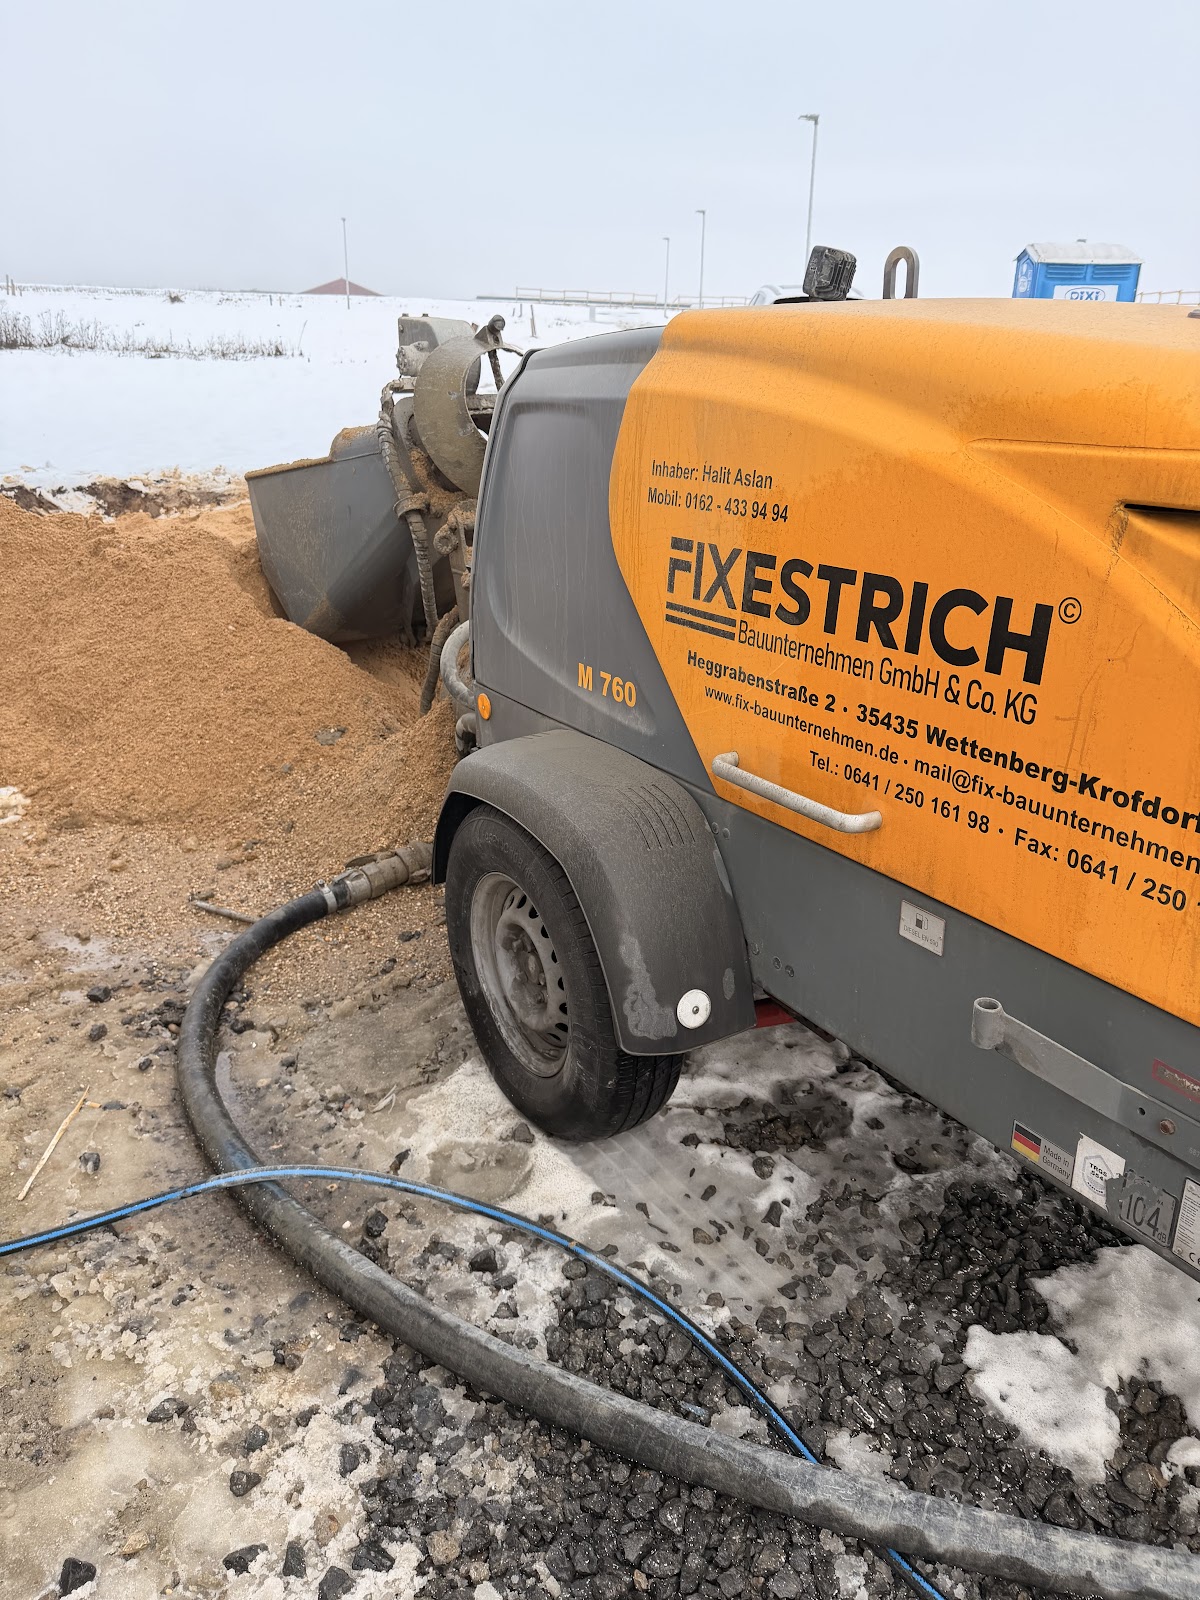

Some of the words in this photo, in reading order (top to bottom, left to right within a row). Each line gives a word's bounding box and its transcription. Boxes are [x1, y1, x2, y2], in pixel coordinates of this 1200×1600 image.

[652, 460, 698, 480] Inhaber:
[702, 463, 731, 484] Halit
[733, 468, 773, 490] Aslan
[647, 487, 681, 507] Mobil:
[685, 493, 713, 512] 0162
[724, 498, 747, 517] 433
[751, 501, 768, 520] 94
[771, 504, 789, 522] 94
[578, 662, 593, 692] M
[600, 671, 637, 708] 760
[738, 620, 874, 681] Bauunternehmen
[879, 657, 940, 699] GmbH
[944, 674, 960, 706] &
[966, 679, 997, 716] Co.
[1003, 688, 1038, 726] KG
[687, 650, 819, 707] Heggrabenstraße
[824, 694, 836, 713] 2
[856, 703, 918, 740] 35435
[704, 685, 899, 765] www.fix-bauunternehmen.de
[914, 756, 1200, 875] mail@fix-bauunternehmen
[809, 750, 839, 776] Tel.:
[844, 764, 879, 791] 0641
[884, 779, 891, 795] /
[894, 782, 924, 808] 250
[931, 797, 960, 824] 161
[967, 810, 990, 834] 98
[1014, 827, 1059, 862] Fax:
[1067, 849, 1118, 885] 0641
[1126, 872, 1137, 891] /
[1141, 877, 1187, 911] 250
[903, 925, 920, 938] DIESEL
[922, 934, 929, 942] EN
[1042, 1155, 1071, 1180] Germany
[1043, 1145, 1061, 1162] Made
[1063, 1156, 1070, 1168] in
[1090, 1162, 1107, 1177] TRGS
[1126, 1194, 1160, 1237] 104
[1157, 1231, 1167, 1244] dB
